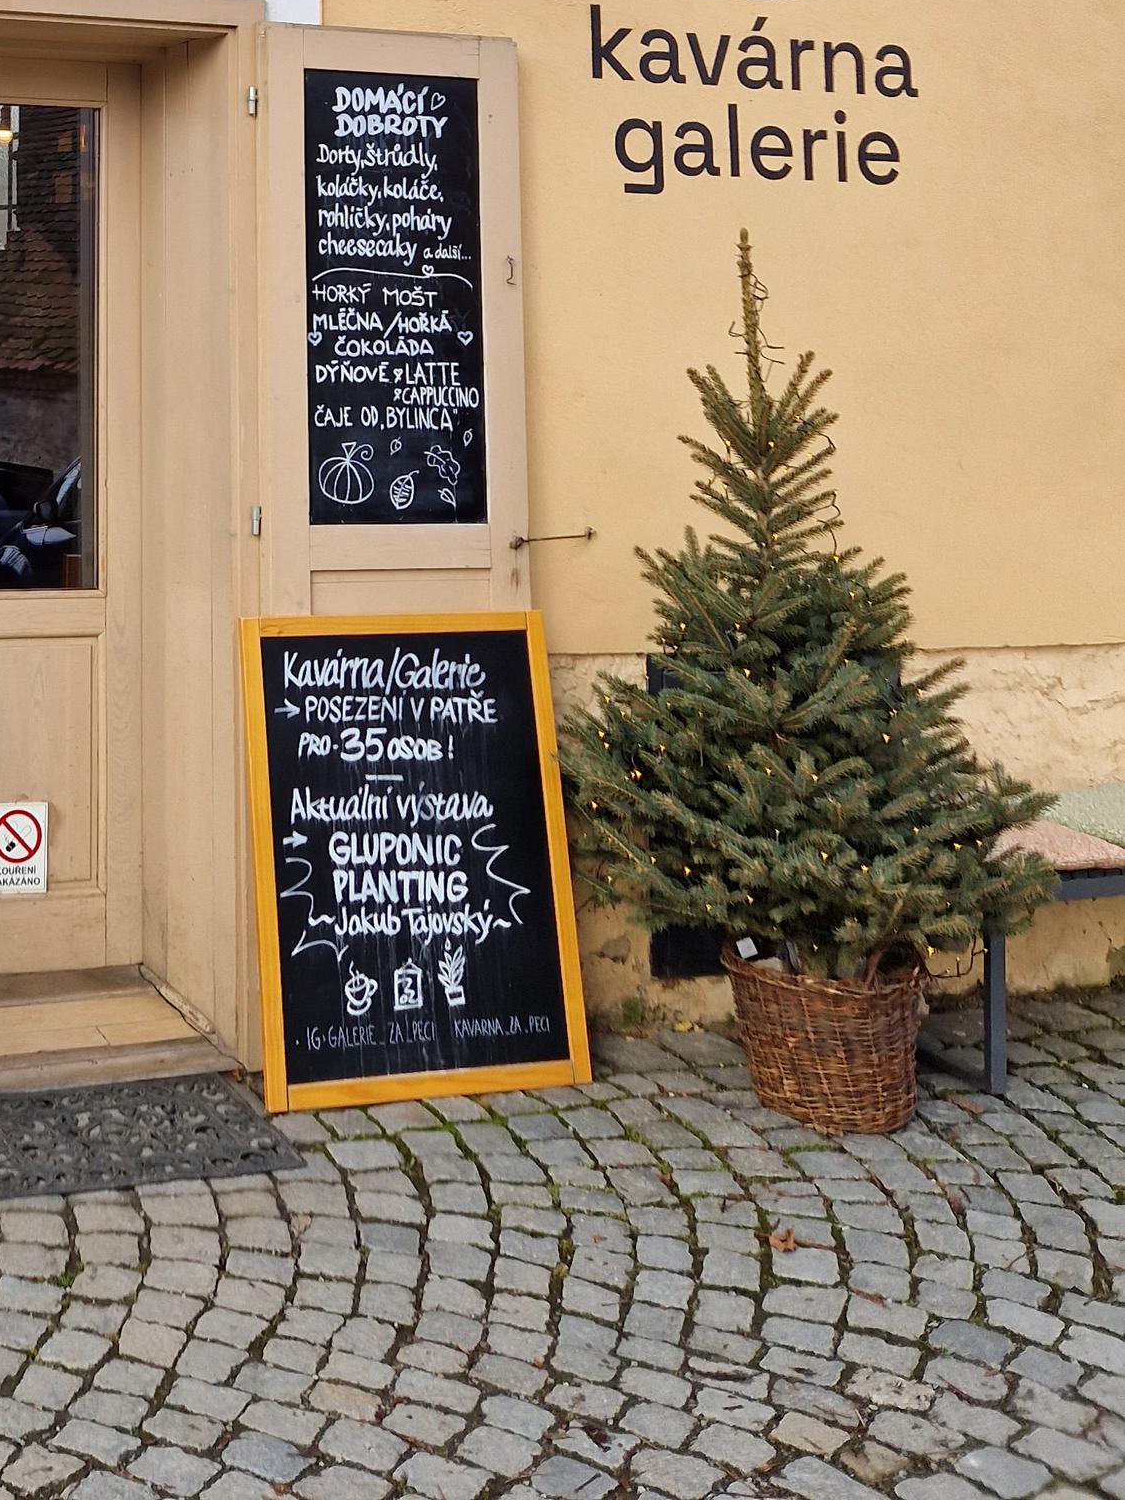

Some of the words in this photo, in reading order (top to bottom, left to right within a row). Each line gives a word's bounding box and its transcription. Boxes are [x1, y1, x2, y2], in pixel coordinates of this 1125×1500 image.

[590, 4, 919, 98] kavárna
[332, 83, 429, 114] DOMÁCÍ
[334, 113, 448, 138] DOBROTY
[614, 103, 901, 195] galerie
[318, 231, 418, 267] cheesecaky
[423, 248, 433, 259] a
[312, 282, 372, 305] HORKÝ
[382, 286, 438, 308] MOŠT
[334, 336, 435, 357] ČOKOLÁDA
[315, 360, 390, 384] DÝŇOVÉ
[405, 362, 461, 386] LATTE
[402, 386, 480, 408] CAPPUCCINO
[314, 404, 353, 428] ČAJE
[304, 690, 406, 724] POSEZENÍ
[410, 697, 425, 723] V
[430, 690, 499, 725] PATŘE
[339, 727, 387, 762] 35
[290, 783, 393, 825] Aktuální
[396, 781, 494, 827] výstava
[328, 831, 463, 867] GLUPONIC
[332, 869, 470, 903] PLANTING
